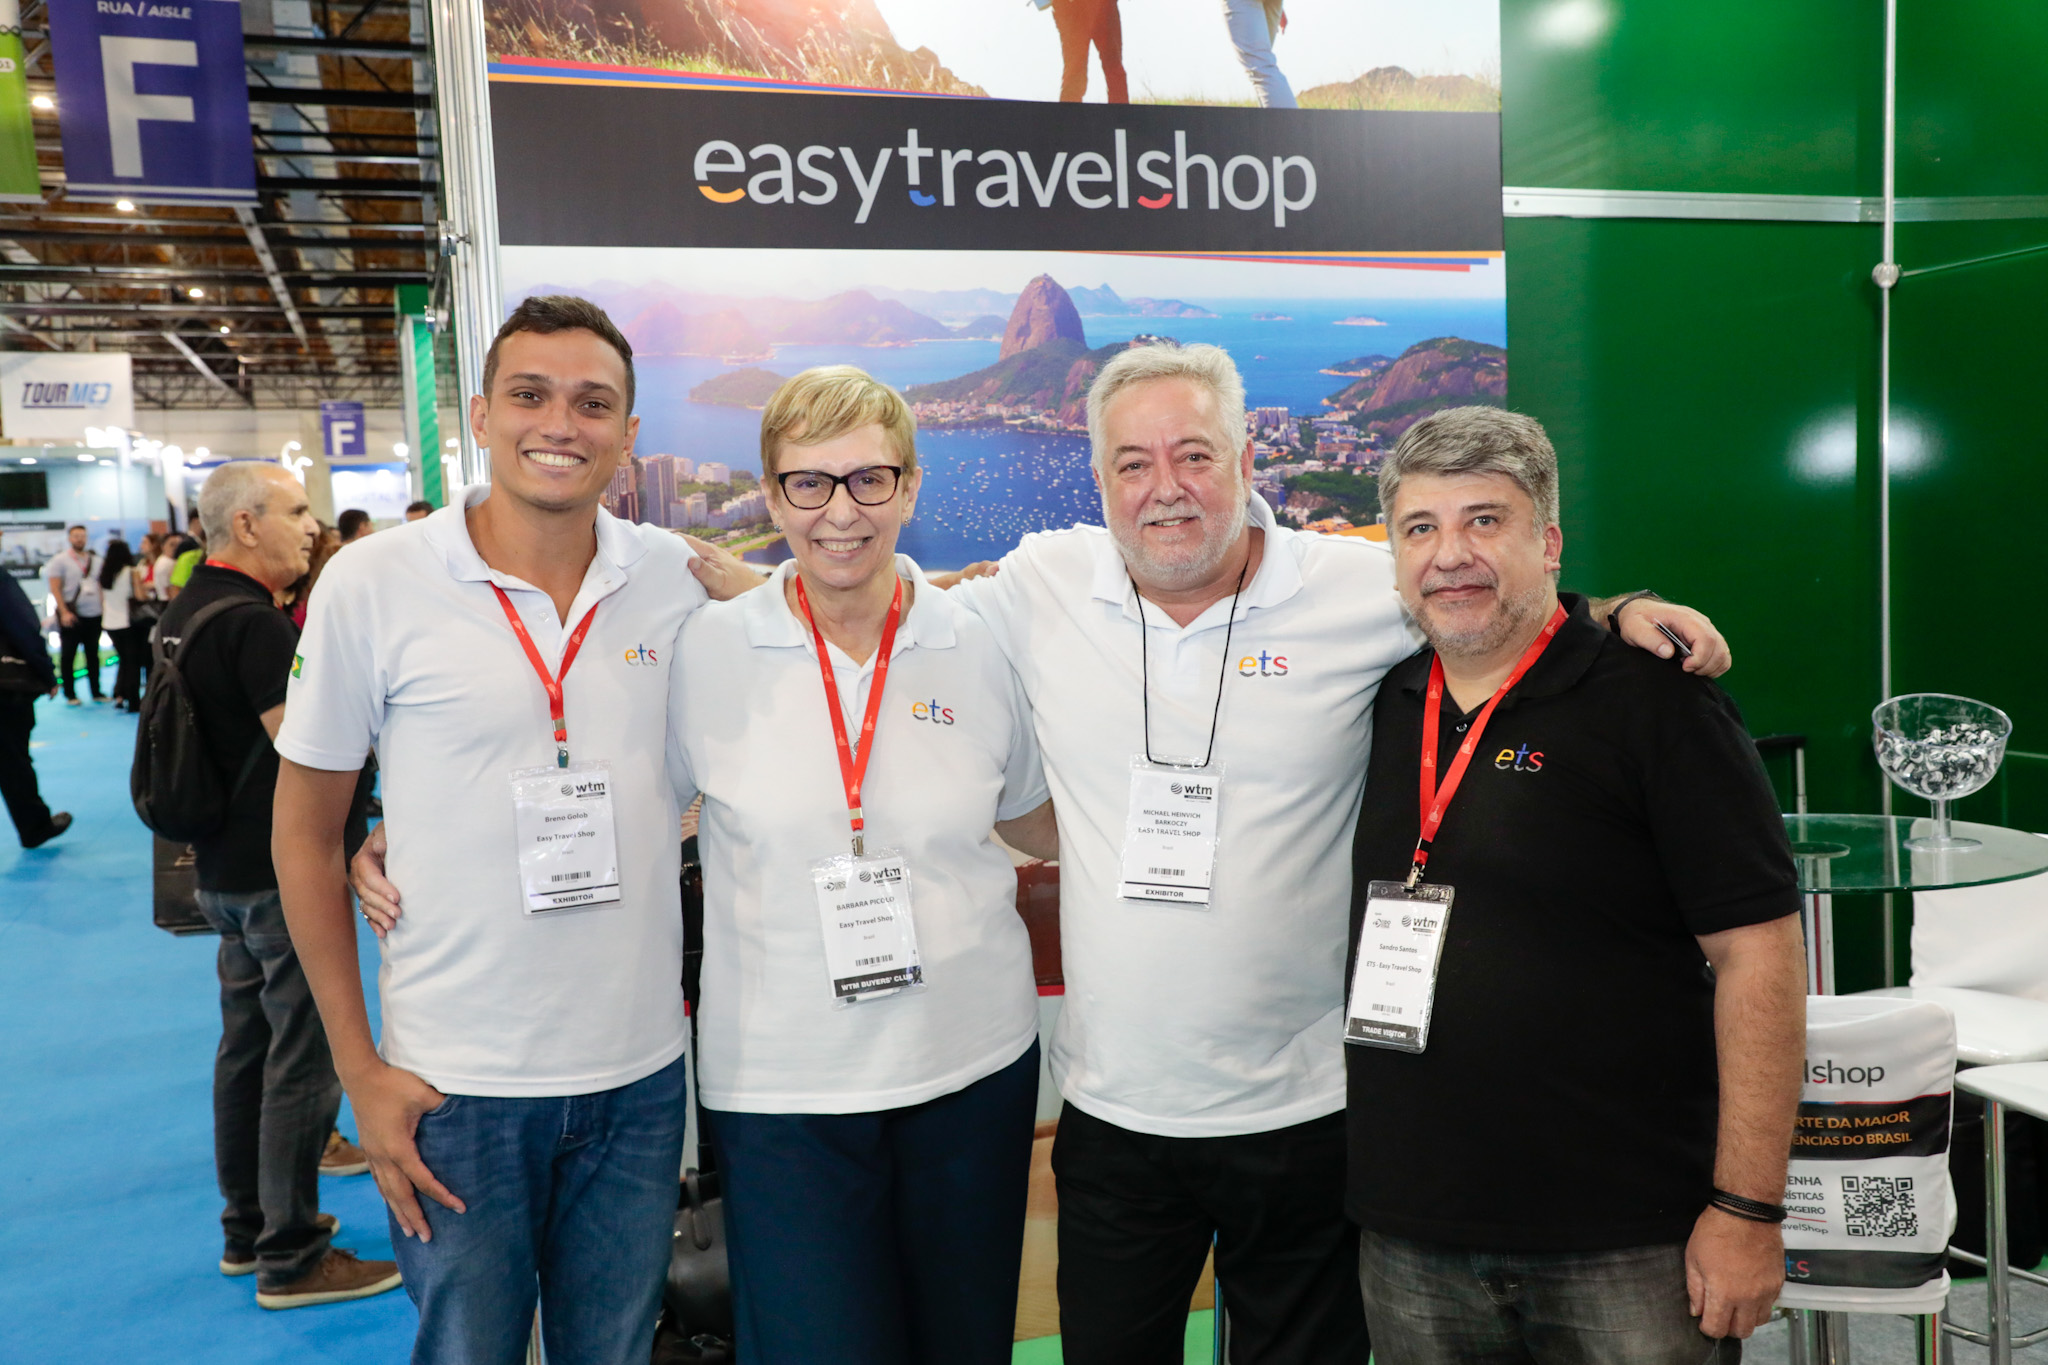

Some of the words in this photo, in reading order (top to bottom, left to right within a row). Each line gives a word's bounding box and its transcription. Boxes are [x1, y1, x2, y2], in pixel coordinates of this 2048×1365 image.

[97, 0, 135, 15] RUA
[148, 5, 192, 19] AISLE
[100, 35, 199, 178] F
[331, 420, 356, 455] F
[624, 643, 658, 667] ets
[1238, 650, 1289, 677] ets
[911, 698, 955, 725] ets
[1494, 743, 1544, 772] ets
[576, 782, 605, 793] wtm
[1184, 784, 1213, 795] wtm
[1143, 809, 1170, 817] MICHAEL
[1155, 819, 1188, 827] BARKOCZY
[554, 832, 576, 840] Travel
[1156, 828, 1181, 836] TRAVEL
[873, 867, 901, 879] wtm
[552, 894, 594, 904] EXHIBITOR
[1145, 889, 1184, 897] EXHIBITOR
[836, 900, 868, 911] BARBARA
[839, 921, 854, 929] Easy
[856, 917, 876, 926] Travel
[1413, 917, 1438, 928] wtm
[1379, 943, 1398, 952] Sandro
[1379, 962, 1391, 971] Easy
[1391, 963, 1408, 971] Travel
[1408, 965, 1422, 973] Shop
[841, 982, 860, 991] WTM
[893, 973, 914, 982] CLUB
[1362, 1025, 1382, 1035] TRADE
[1383, 1028, 1407, 1039] VISITOR
[1827, 1117, 1852, 1129] DA
[1854, 1110, 1911, 1127] MAIOR
[1843, 1135, 1864, 1146] DO
[1866, 1132, 1913, 1145] BRASIL
